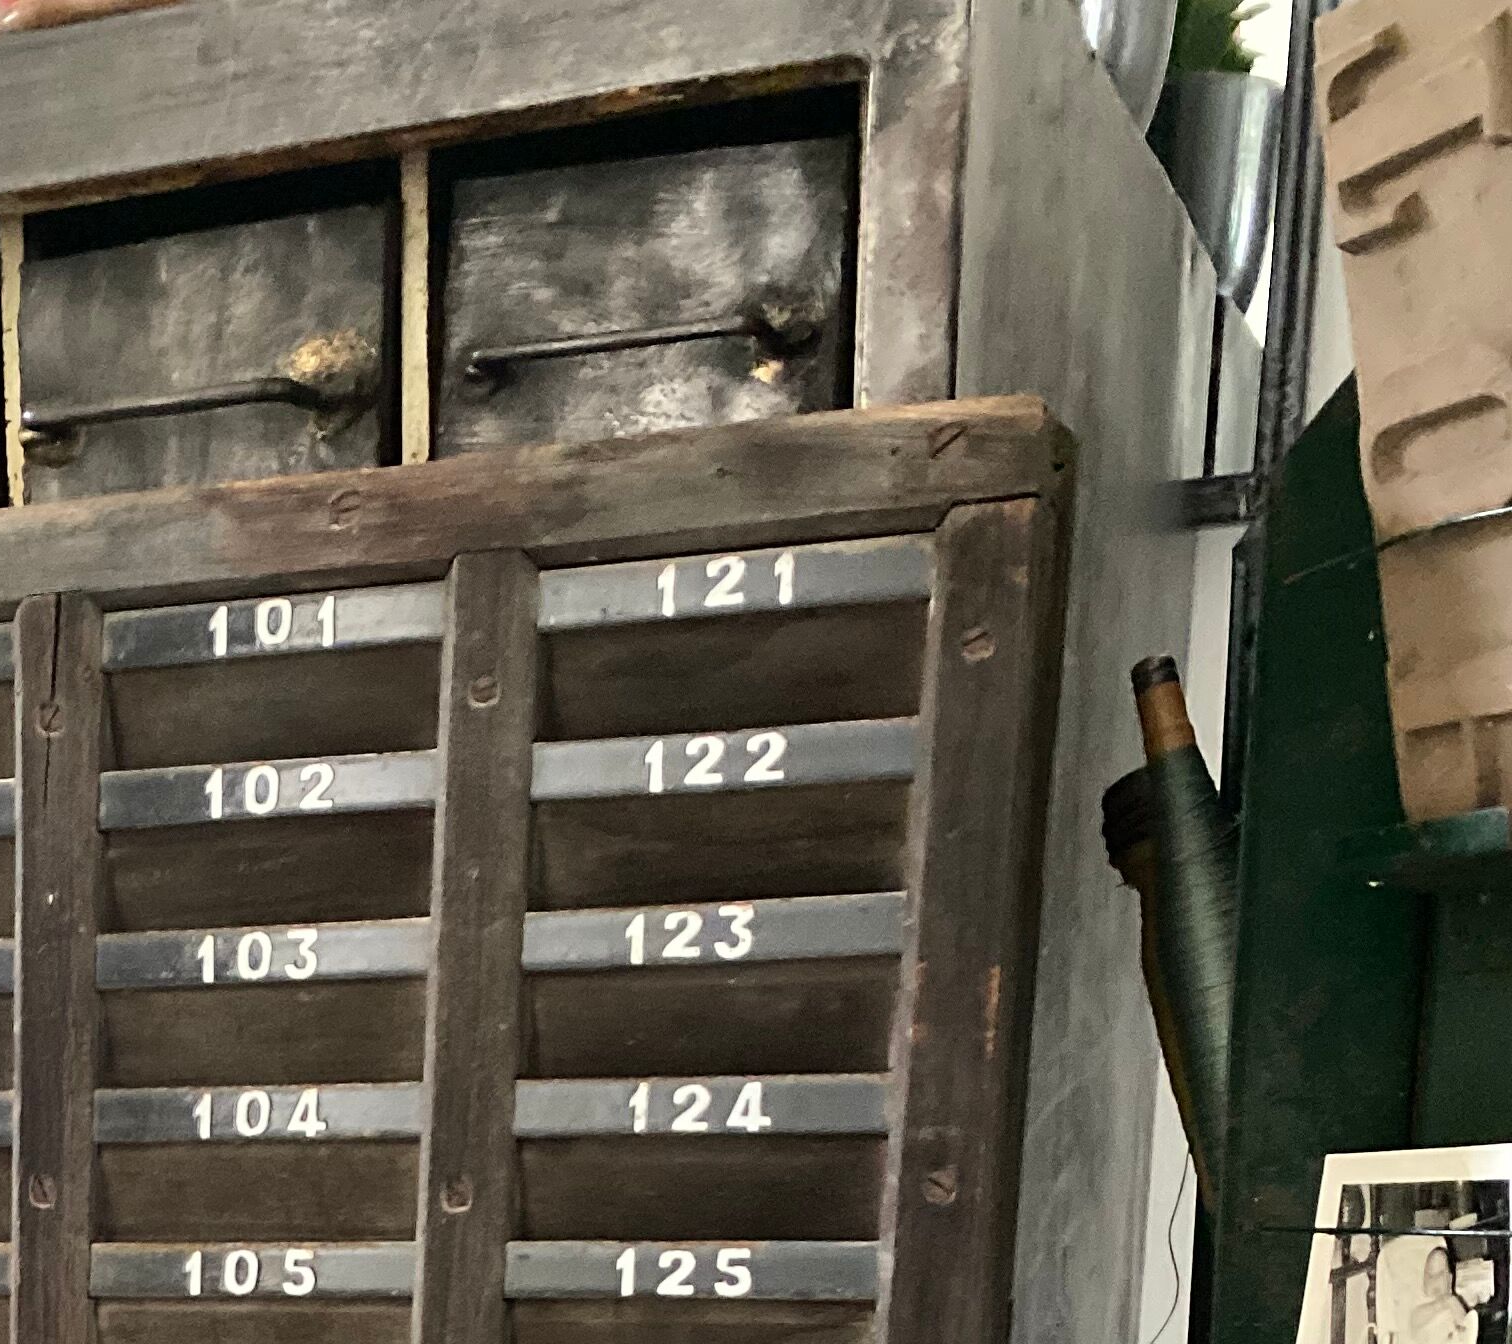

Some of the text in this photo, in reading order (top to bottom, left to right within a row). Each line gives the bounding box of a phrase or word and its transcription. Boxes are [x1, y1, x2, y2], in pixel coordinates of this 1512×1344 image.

[208, 595, 335, 658] 101
[644, 732, 788, 794] 122
[196, 931, 317, 984] 103
[625, 905, 754, 966] 123
[192, 1088, 327, 1140] 104
[628, 1081, 772, 1134] 124
[184, 1249, 317, 1297] 105
